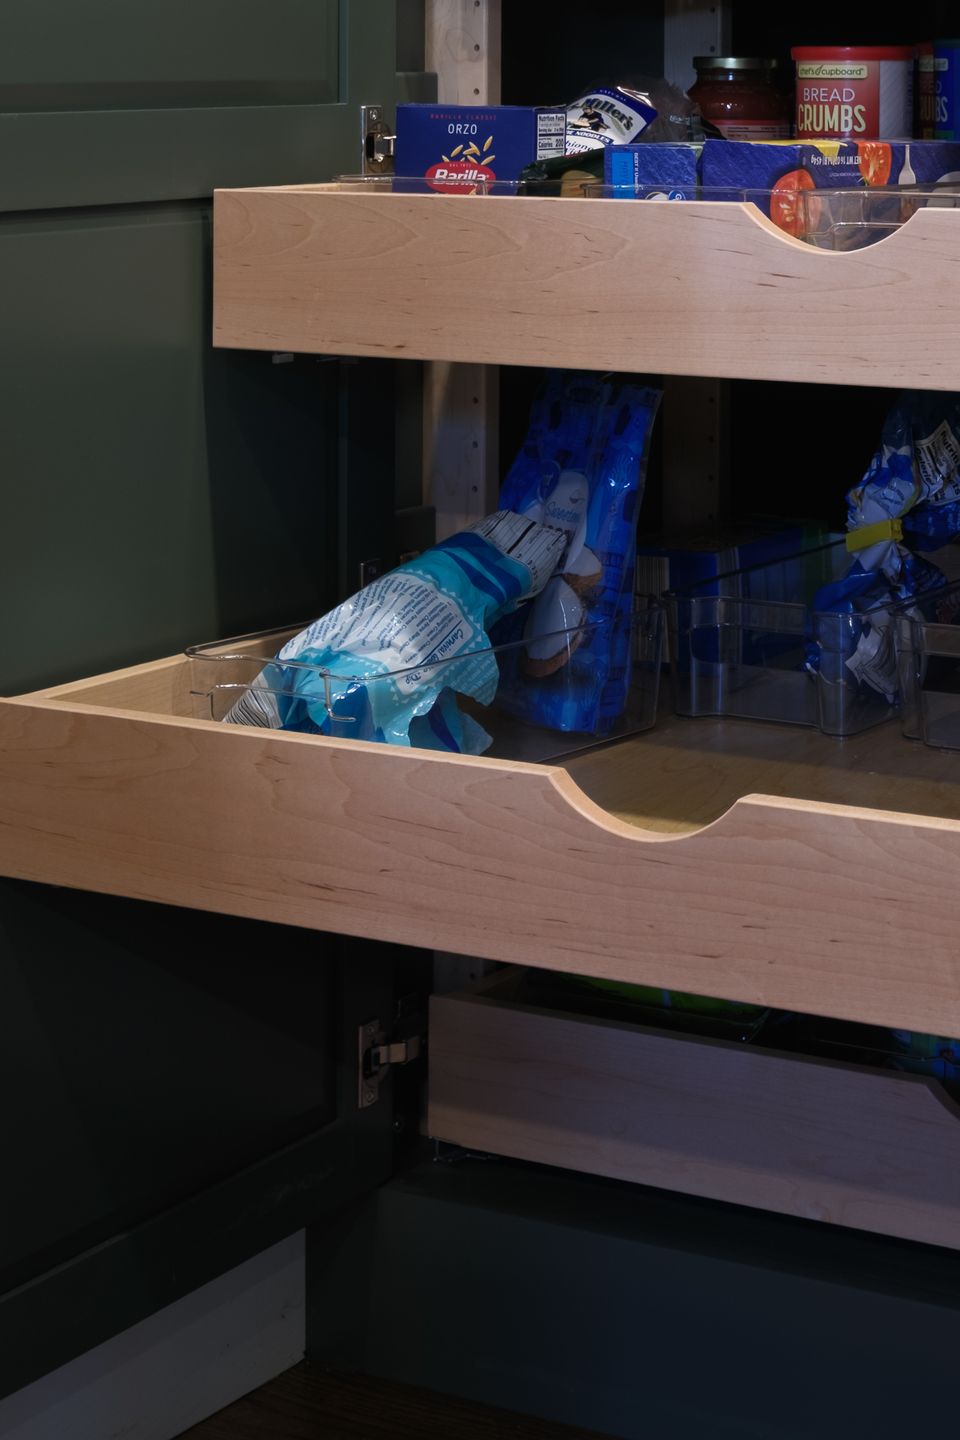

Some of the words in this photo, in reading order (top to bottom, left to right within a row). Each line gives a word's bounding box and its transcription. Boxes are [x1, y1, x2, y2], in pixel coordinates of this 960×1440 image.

[821, 67, 862, 78] cupboard
[803, 87, 856, 102] BREAD
[798, 104, 867, 133] CRUMBS
[447, 123, 478, 135] ORZO
[575, 130, 610, 143] NOODLES
[436, 627, 466, 658] Carnival
